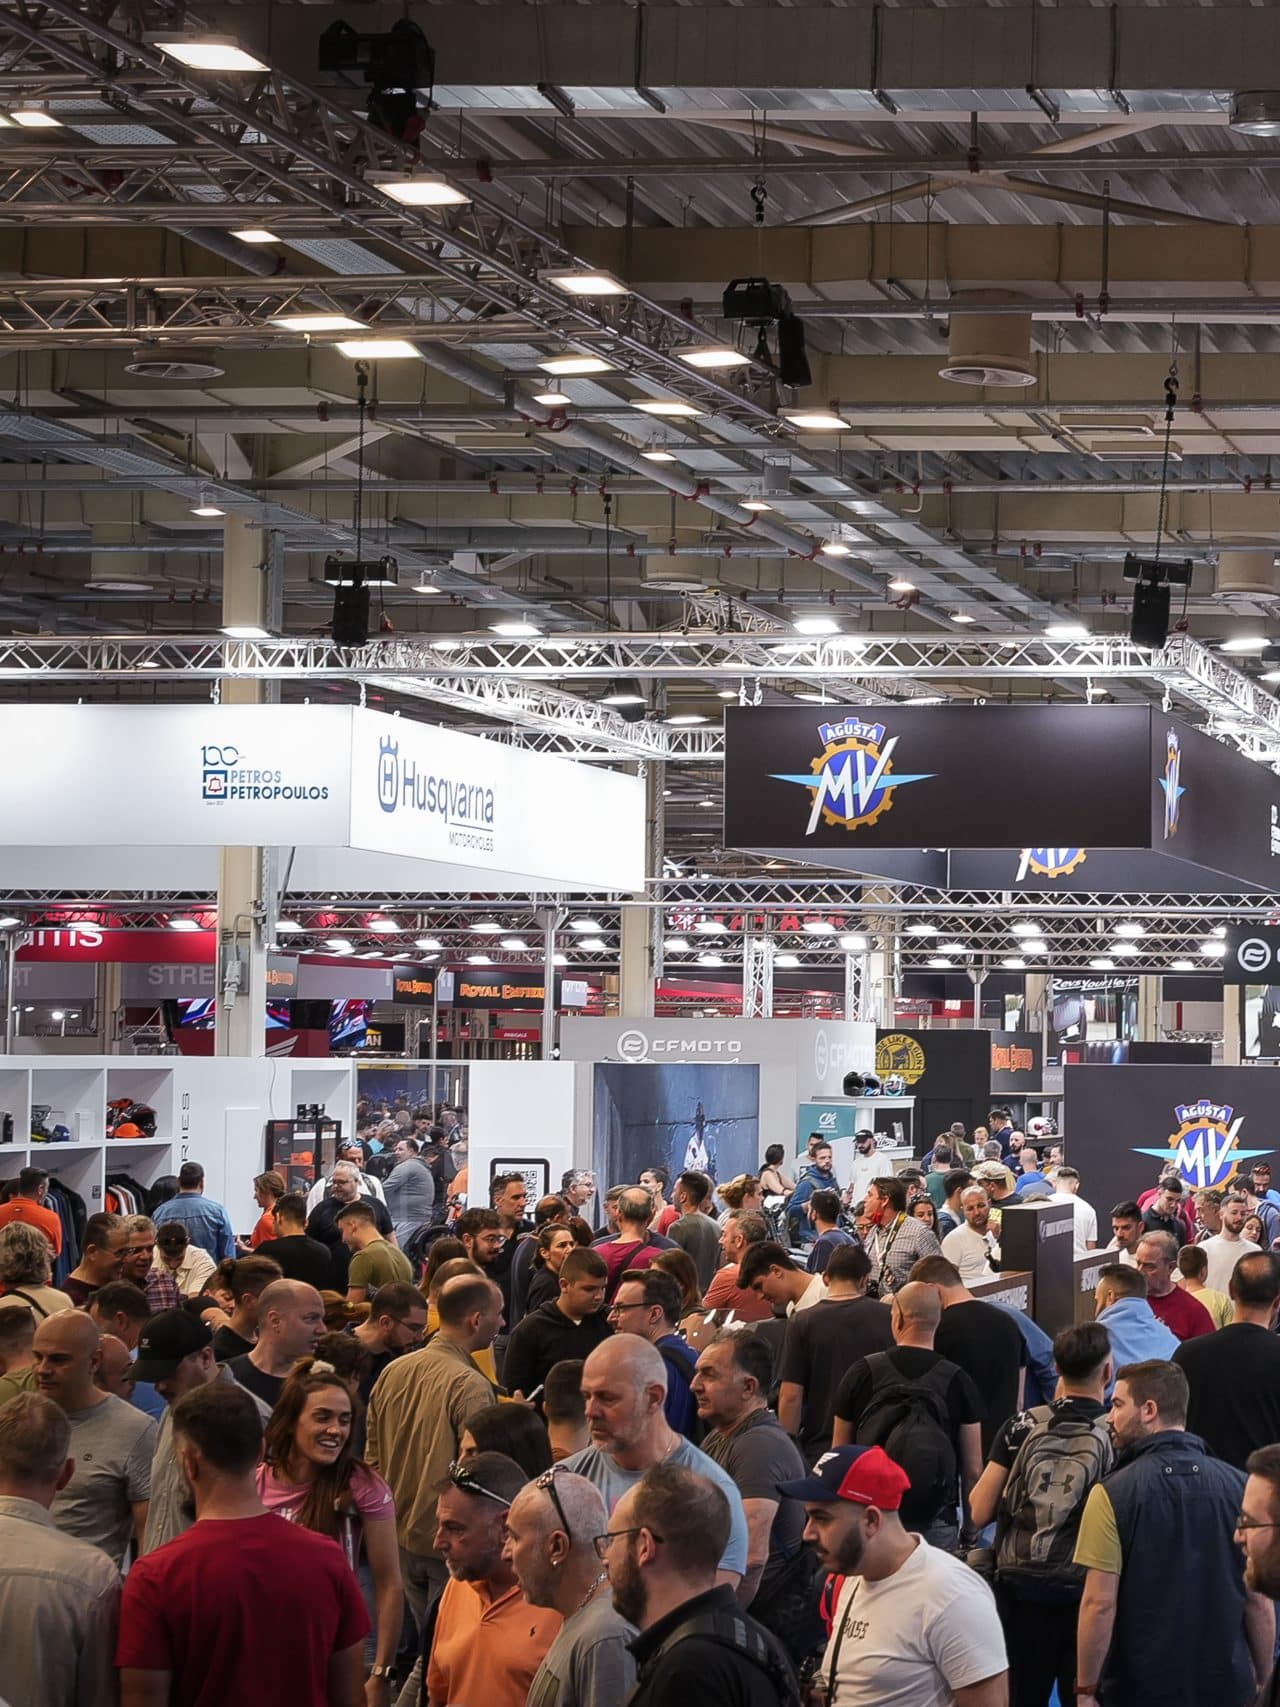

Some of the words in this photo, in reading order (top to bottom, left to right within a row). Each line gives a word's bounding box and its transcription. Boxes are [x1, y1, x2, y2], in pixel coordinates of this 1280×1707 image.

[826, 724, 878, 741] AGUSTA
[230, 770, 282, 784] PETROS
[230, 786, 329, 800] PETROPOULOS
[402, 759, 495, 824] Husqvarna
[805, 735, 901, 836] MV
[459, 983, 501, 998] ROYAL
[651, 1040, 743, 1053] CFMOTO
[1181, 1105, 1226, 1120] AGUSTA
[1174, 1116, 1246, 1189] MV
